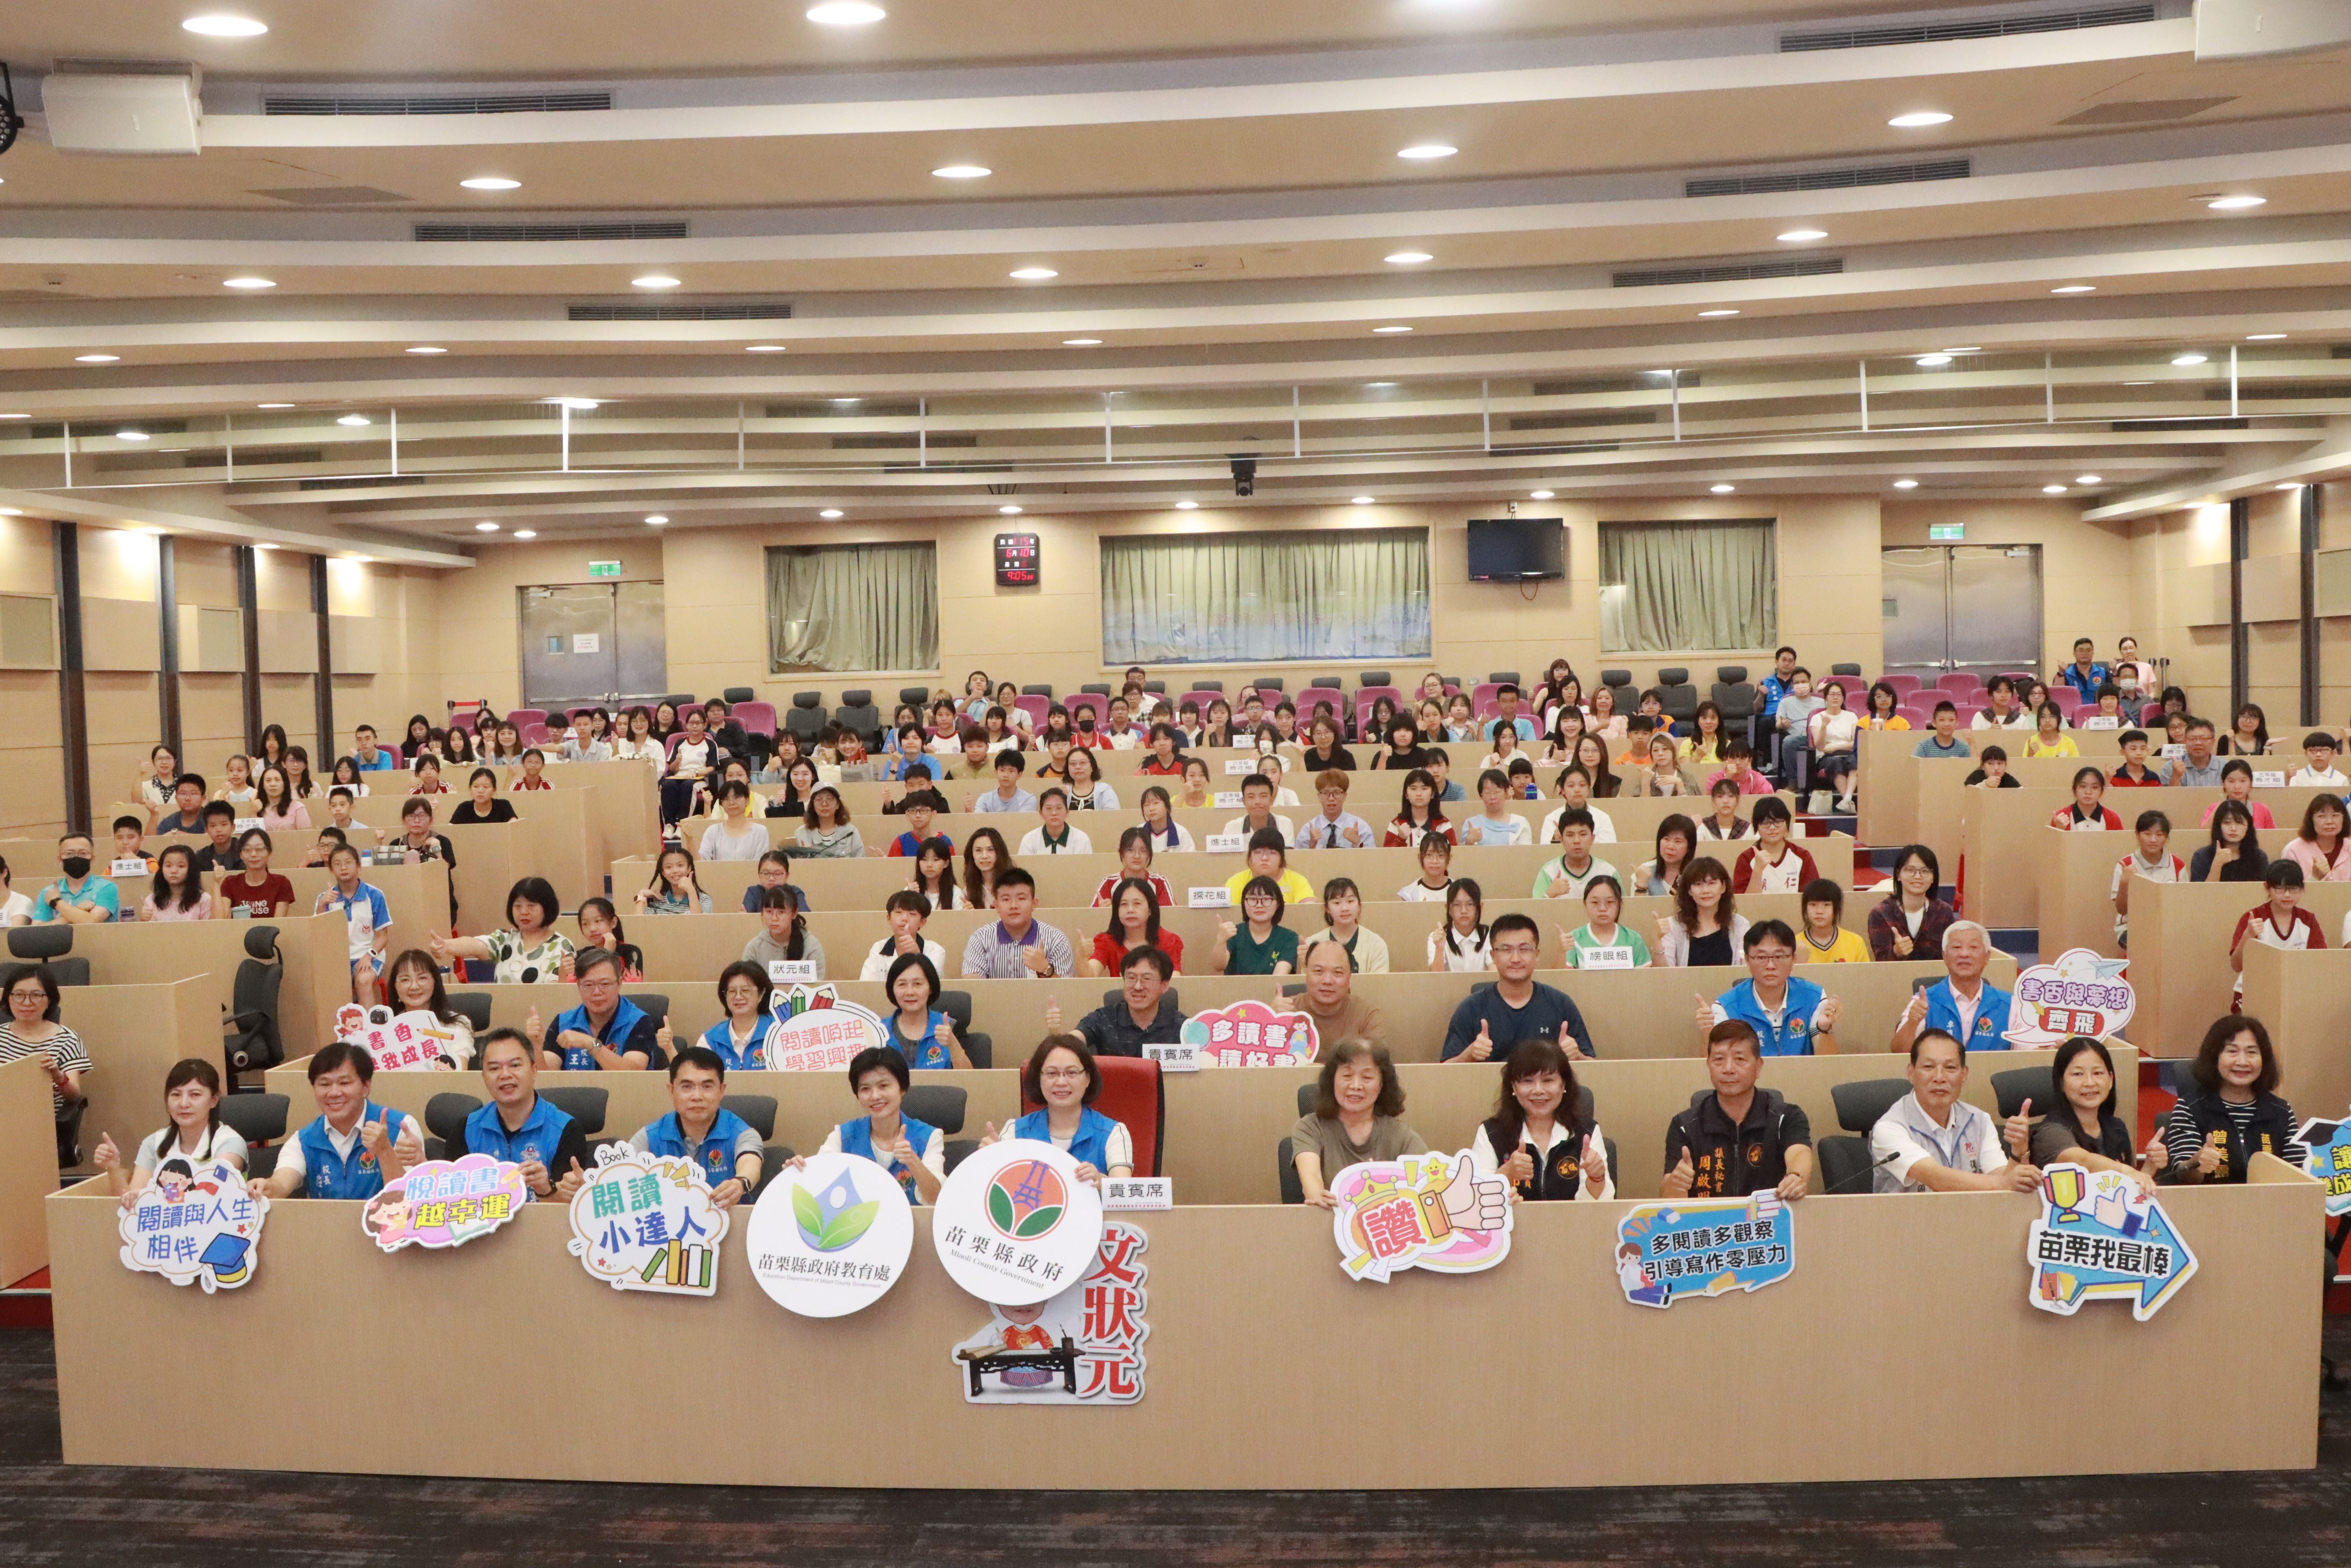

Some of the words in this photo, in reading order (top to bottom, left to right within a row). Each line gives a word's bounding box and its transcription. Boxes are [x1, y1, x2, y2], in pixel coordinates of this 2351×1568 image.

[1210, 838, 1240, 846] 進士組
[115, 862, 142, 871] 進士組
[1193, 891, 1226, 900] 探花組
[773, 964, 810, 975] 狀元組
[1590, 950, 1628, 962] 榜眼組
[2021, 977, 2129, 1010] 書香與夢想
[779, 1019, 865, 1053] 閱讀喚起
[1211, 1019, 1288, 1049] 多讀書
[2047, 1010, 2097, 1035] 齊飛
[1147, 1048, 1193, 1061] 貴賓席
[600, 1147, 630, 1166] Book
[404, 1166, 501, 1201] 悅讀書
[591, 1173, 663, 1219] 閱讀
[1108, 1182, 1164, 1198] 貴賓席
[137, 1198, 254, 1233] 閱讀與人生
[413, 1193, 512, 1230] 越幸運
[599, 1205, 707, 1254] 小達人
[1651, 1220, 1774, 1255] 多閱讀多觀察
[147, 1234, 199, 1264] 相伴
[945, 1226, 1064, 1281] 苗栗縣政府
[1645, 1244, 1786, 1281] 引導寫作零壓力
[2038, 1231, 2169, 1276] 苗栗我最棒
[758, 1253, 891, 1282] 苗栗縣政府教育處
[950, 1249, 971, 1262] Miaoli
[973, 1258, 999, 1273] County
[1000, 1267, 1044, 1289] Government
[1080, 1228, 1138, 1395] 文狀元
